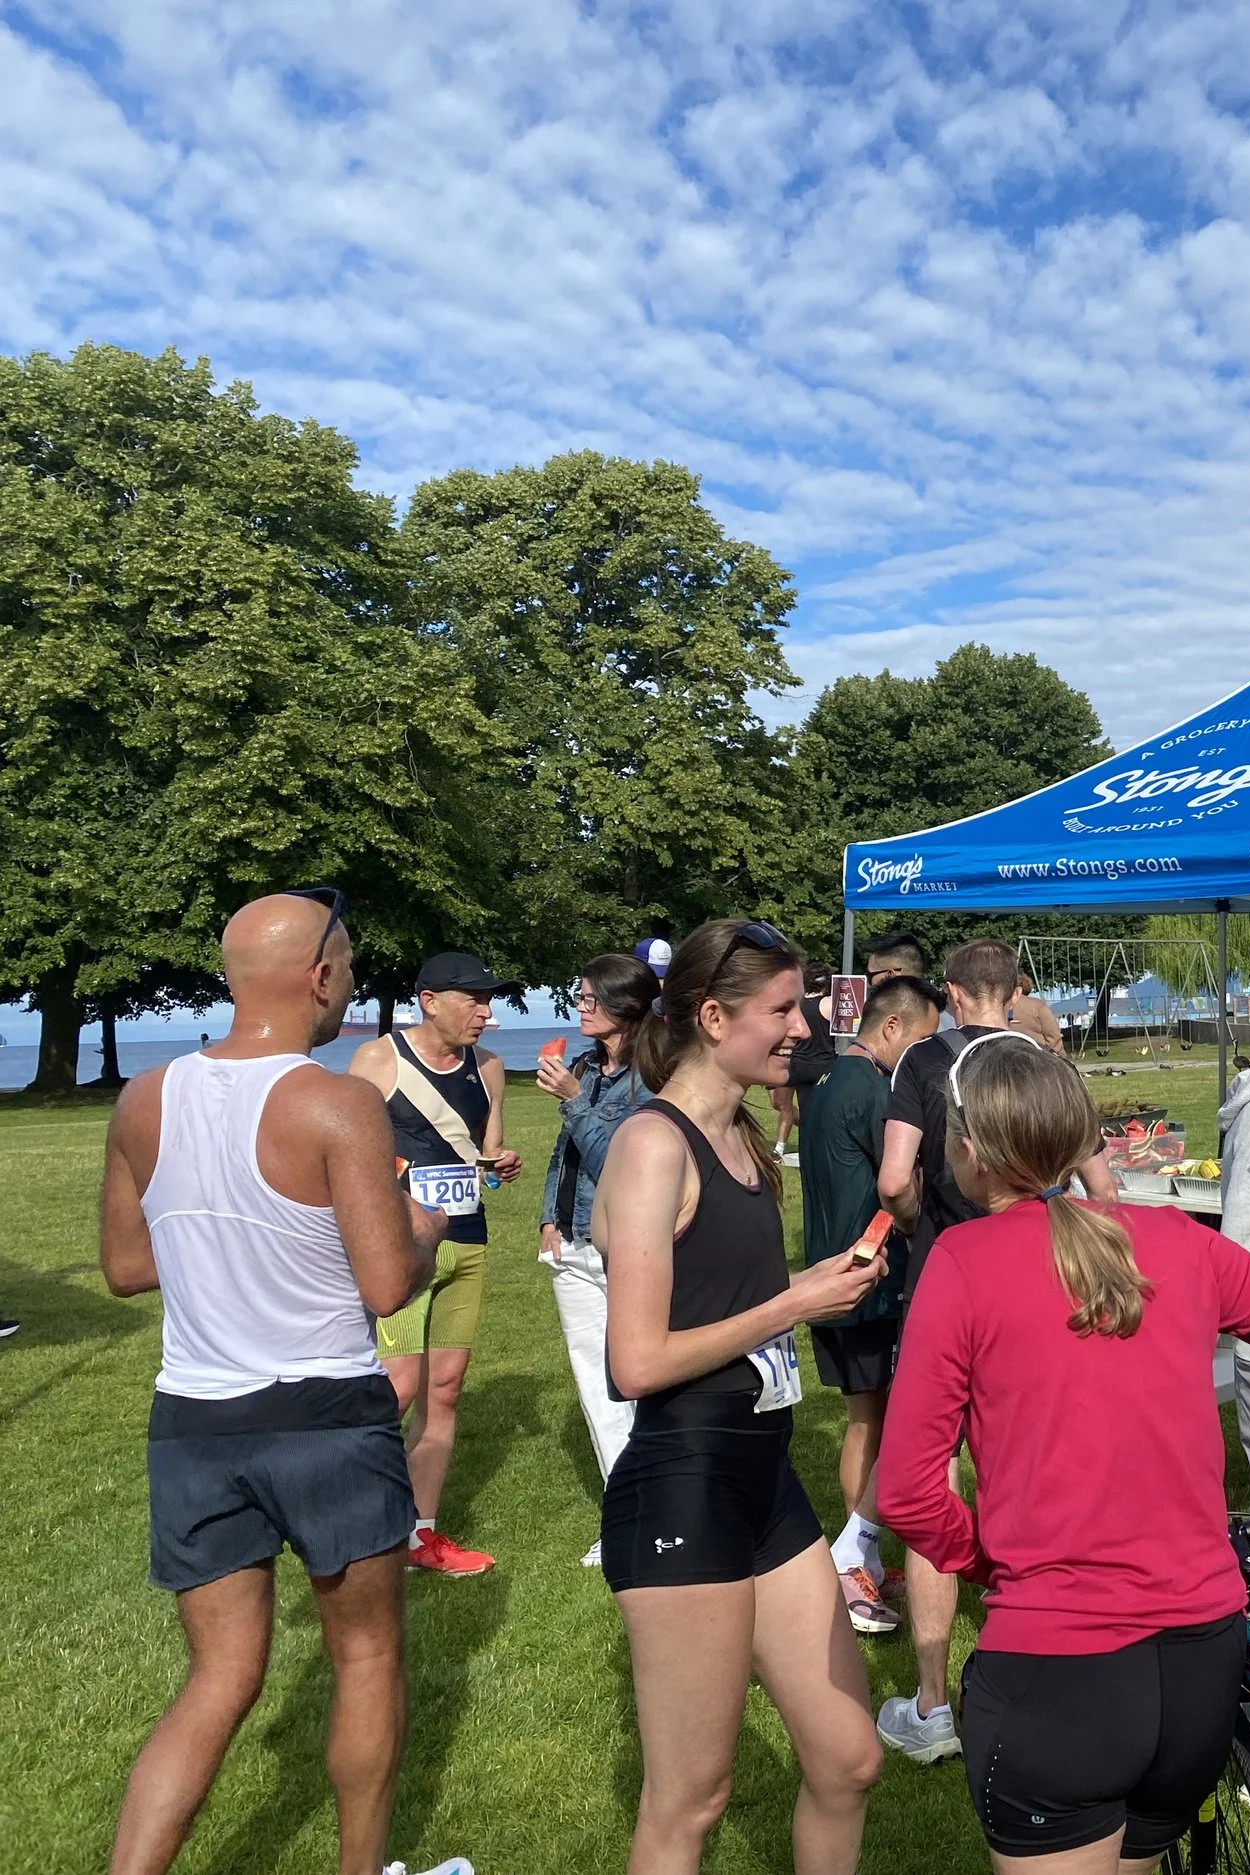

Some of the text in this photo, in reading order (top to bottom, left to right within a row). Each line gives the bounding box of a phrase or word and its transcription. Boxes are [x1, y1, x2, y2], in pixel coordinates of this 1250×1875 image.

[1141, 751, 1155, 761] A
[1197, 747, 1226, 758] EST
[1086, 817, 1184, 834] AROUND
[1190, 799, 1240, 821] YOU
[857, 852, 923, 894] Stong's
[997, 856, 1183, 880] www.Stongs.com
[913, 881, 957, 892] MARKET
[419, 1180, 476, 1204] 1204
